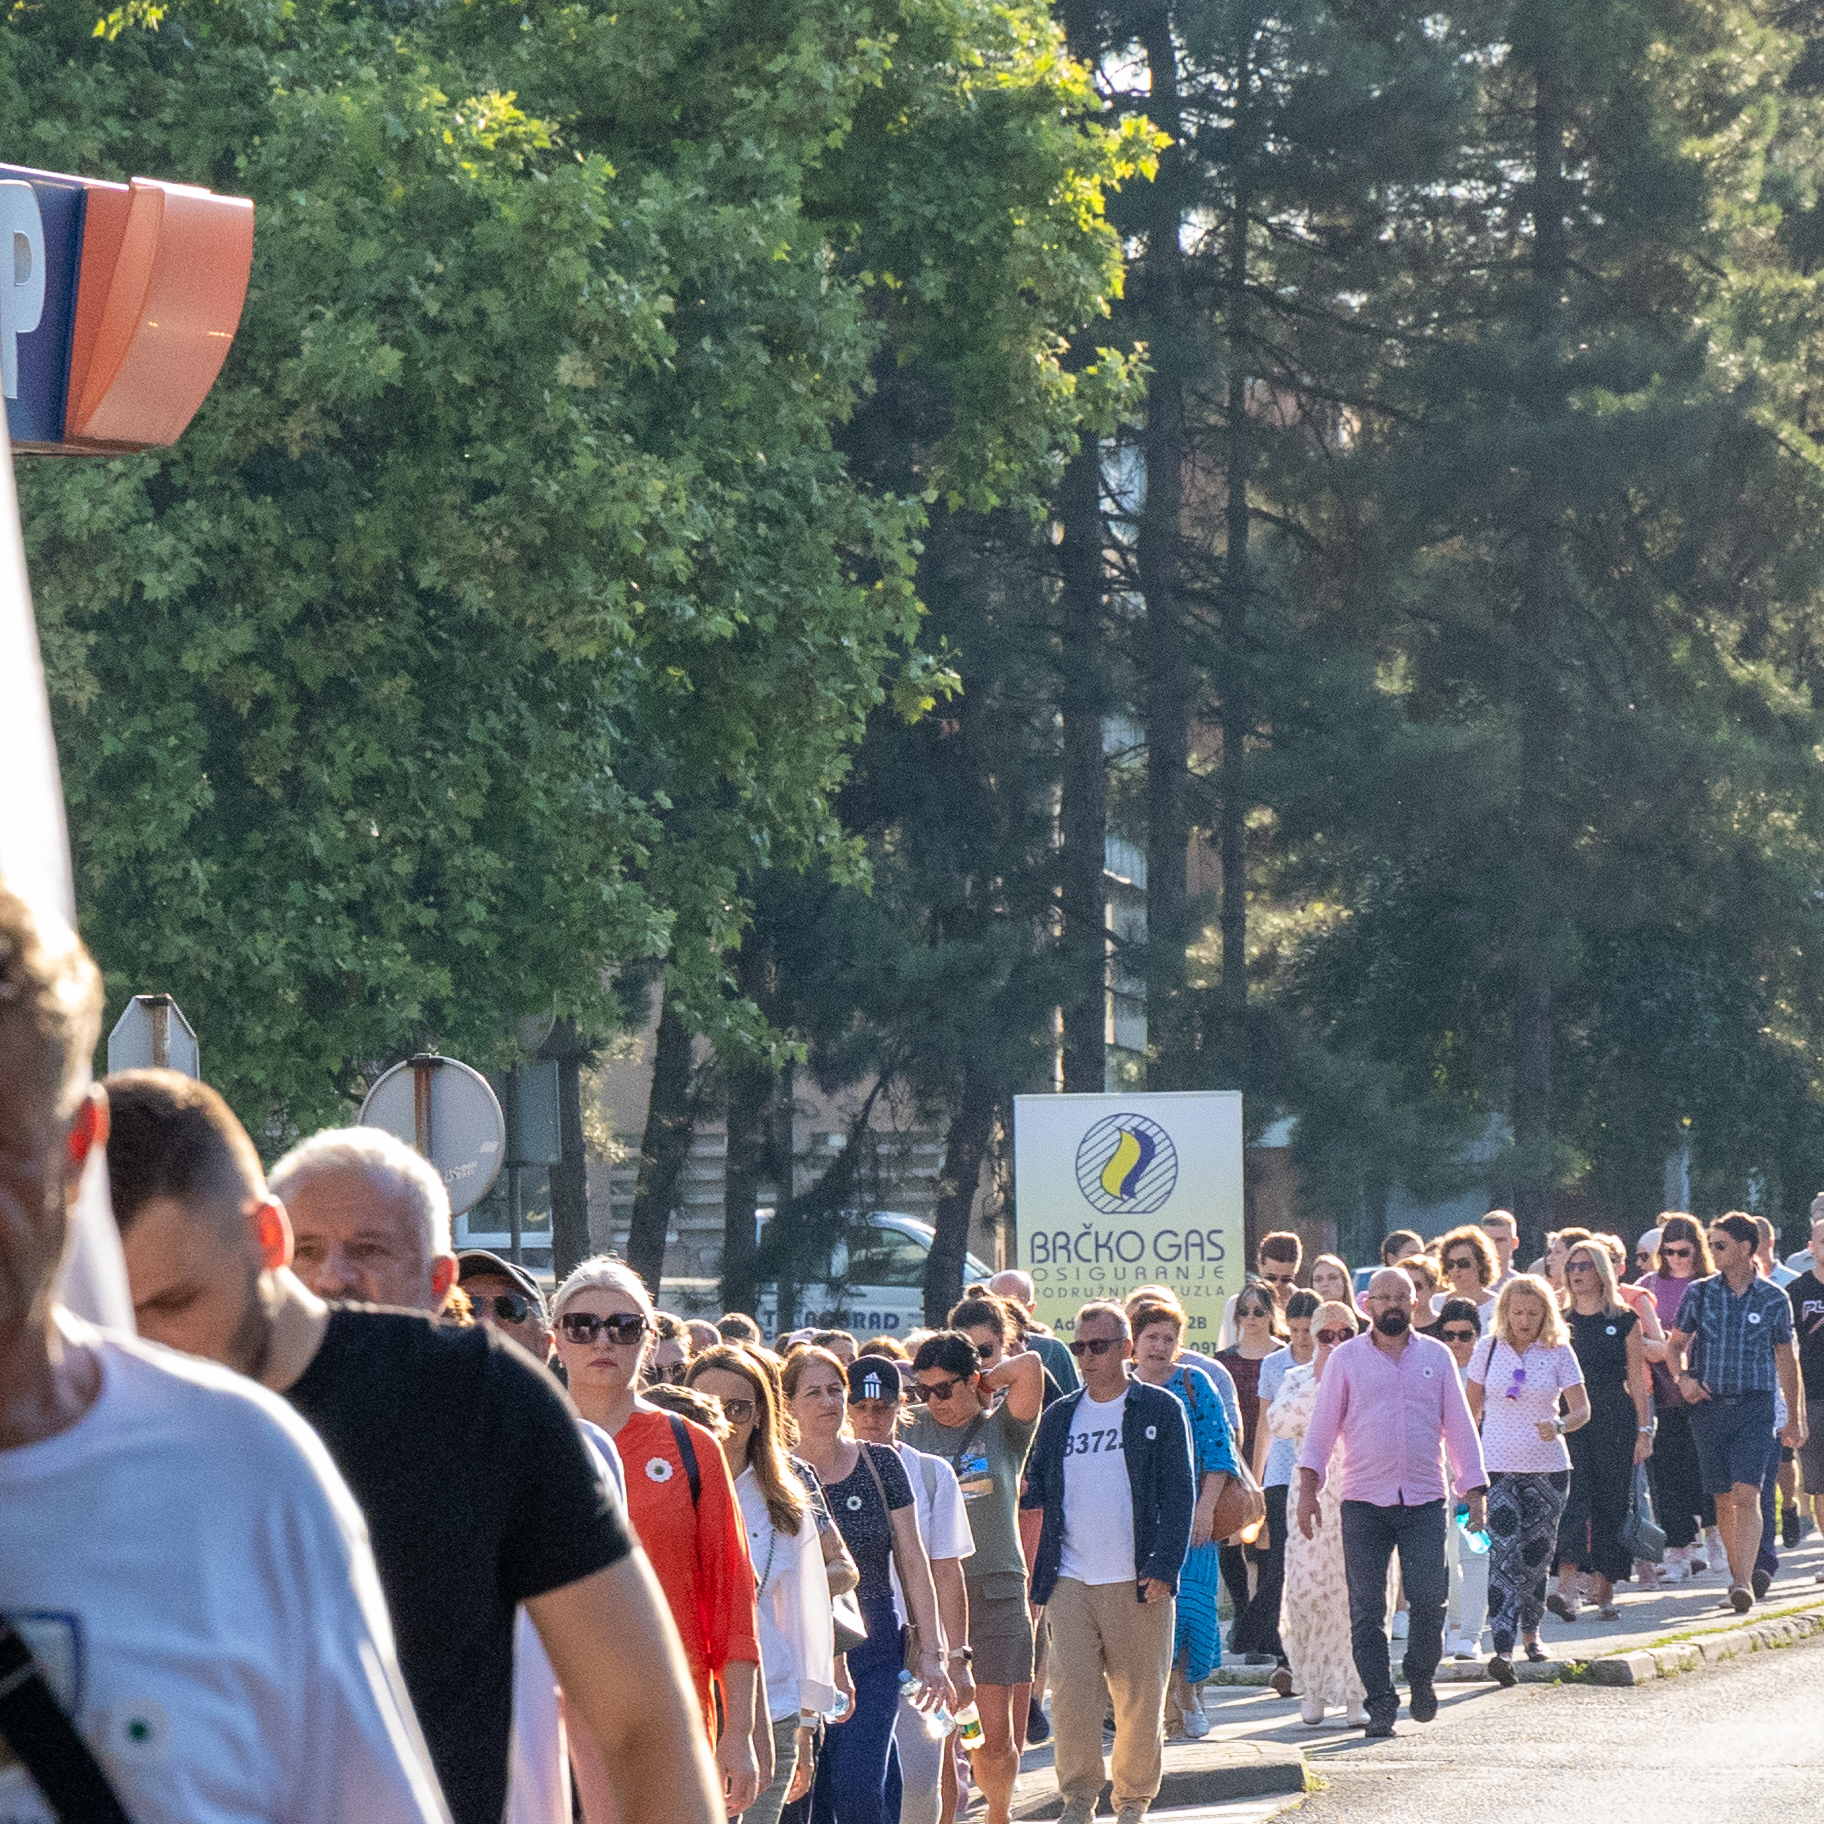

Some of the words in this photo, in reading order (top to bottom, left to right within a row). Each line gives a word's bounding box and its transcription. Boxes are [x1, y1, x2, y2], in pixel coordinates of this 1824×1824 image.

[1030, 1222, 1145, 1264] BRČKO
[1153, 1229, 1226, 1262] GAS
[1031, 1265, 1225, 1281] OSIGURANJE
[1035, 1283, 1136, 1299] ODRUŽNI
